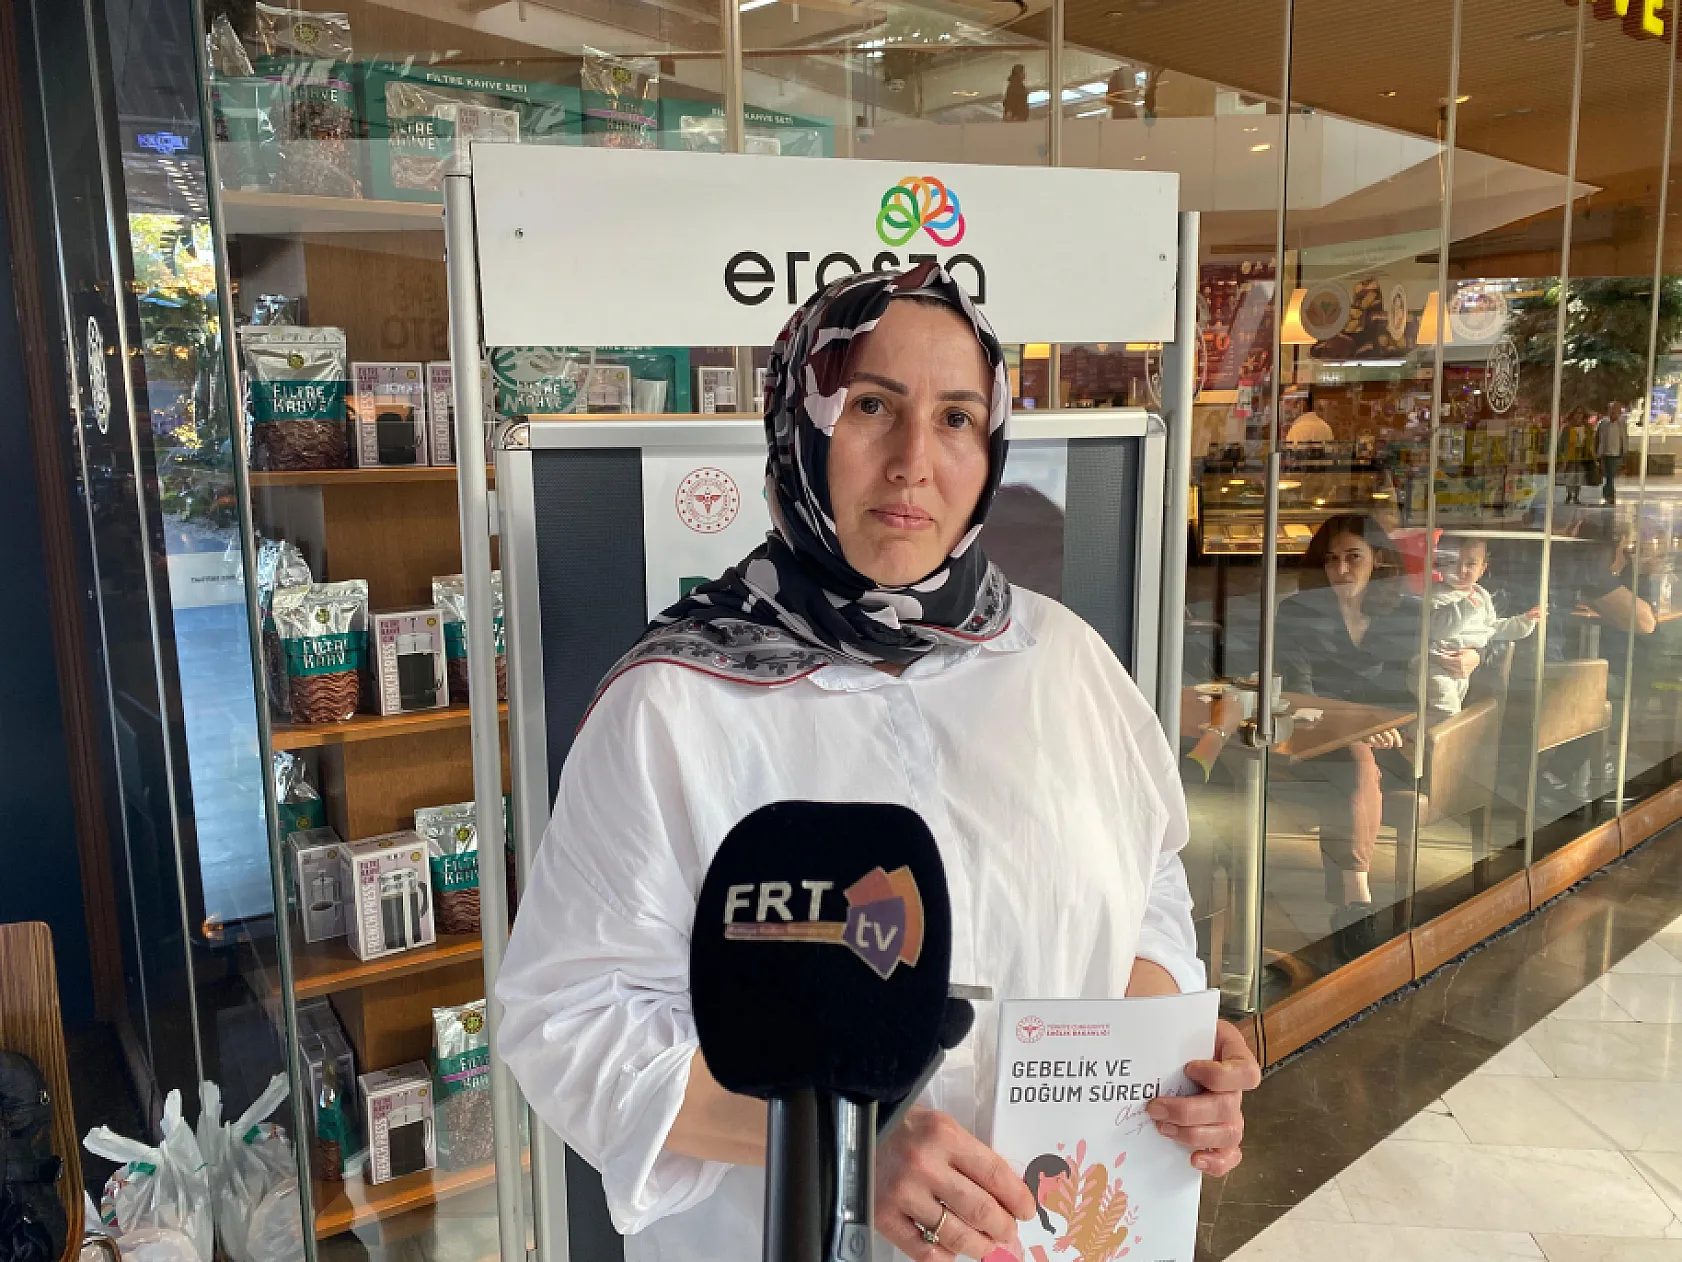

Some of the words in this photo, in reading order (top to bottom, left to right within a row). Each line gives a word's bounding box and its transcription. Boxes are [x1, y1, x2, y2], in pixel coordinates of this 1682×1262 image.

[273, 399, 327, 413] KAHVE
[444, 870, 478, 886] KAH
[723, 879, 834, 924] FRT
[855, 912, 898, 951] tv
[1011, 1055, 1098, 1079] GEBELİK
[1105, 1059, 1132, 1078] VE
[461, 1074, 490, 1088] KAH
[1009, 1083, 1083, 1105] DOĞUM
[1088, 1077, 1161, 1103] SÜRECİ
